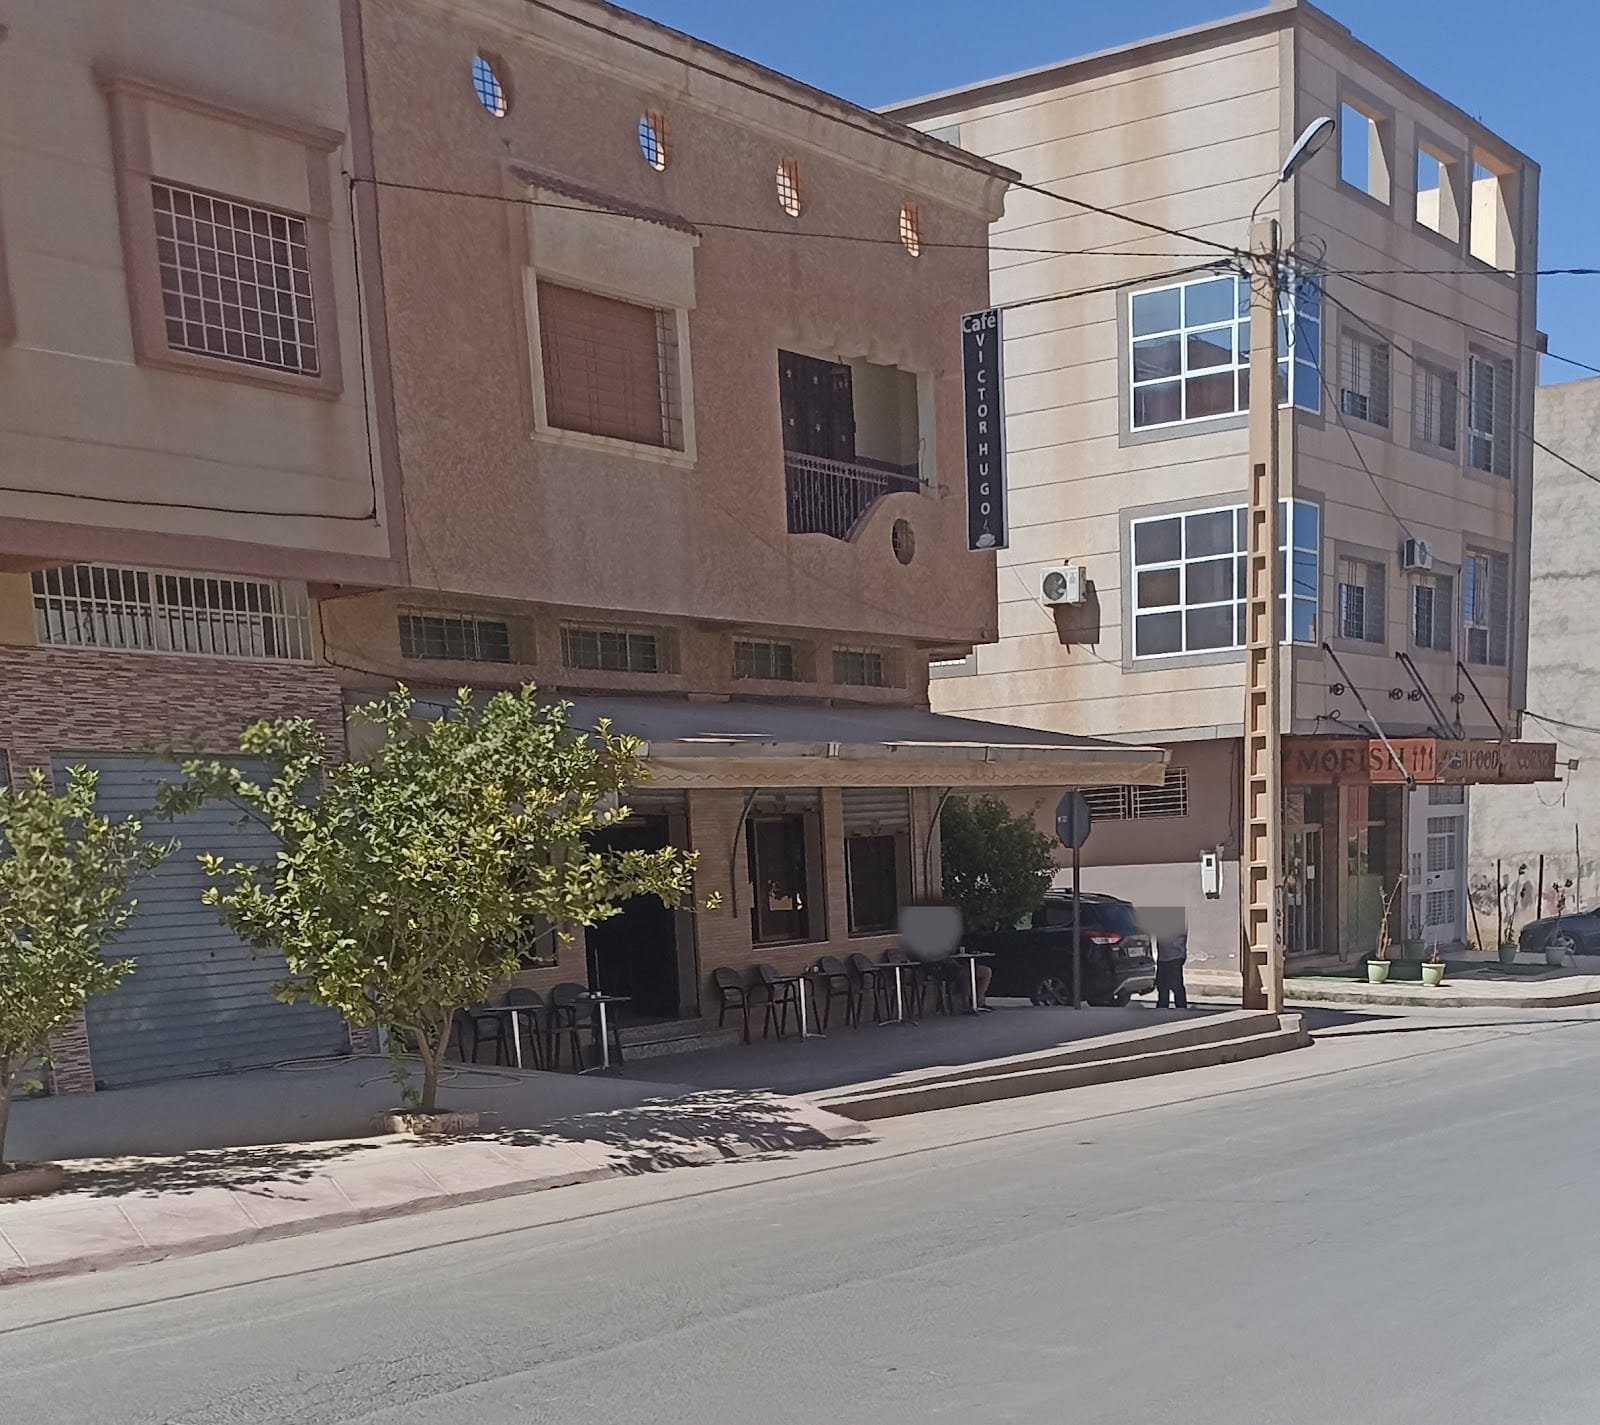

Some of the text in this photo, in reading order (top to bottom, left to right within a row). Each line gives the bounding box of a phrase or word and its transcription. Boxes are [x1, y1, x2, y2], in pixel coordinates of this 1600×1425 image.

[962, 310, 996, 333] Café
[976, 334, 991, 515] VICTOR HUGO
